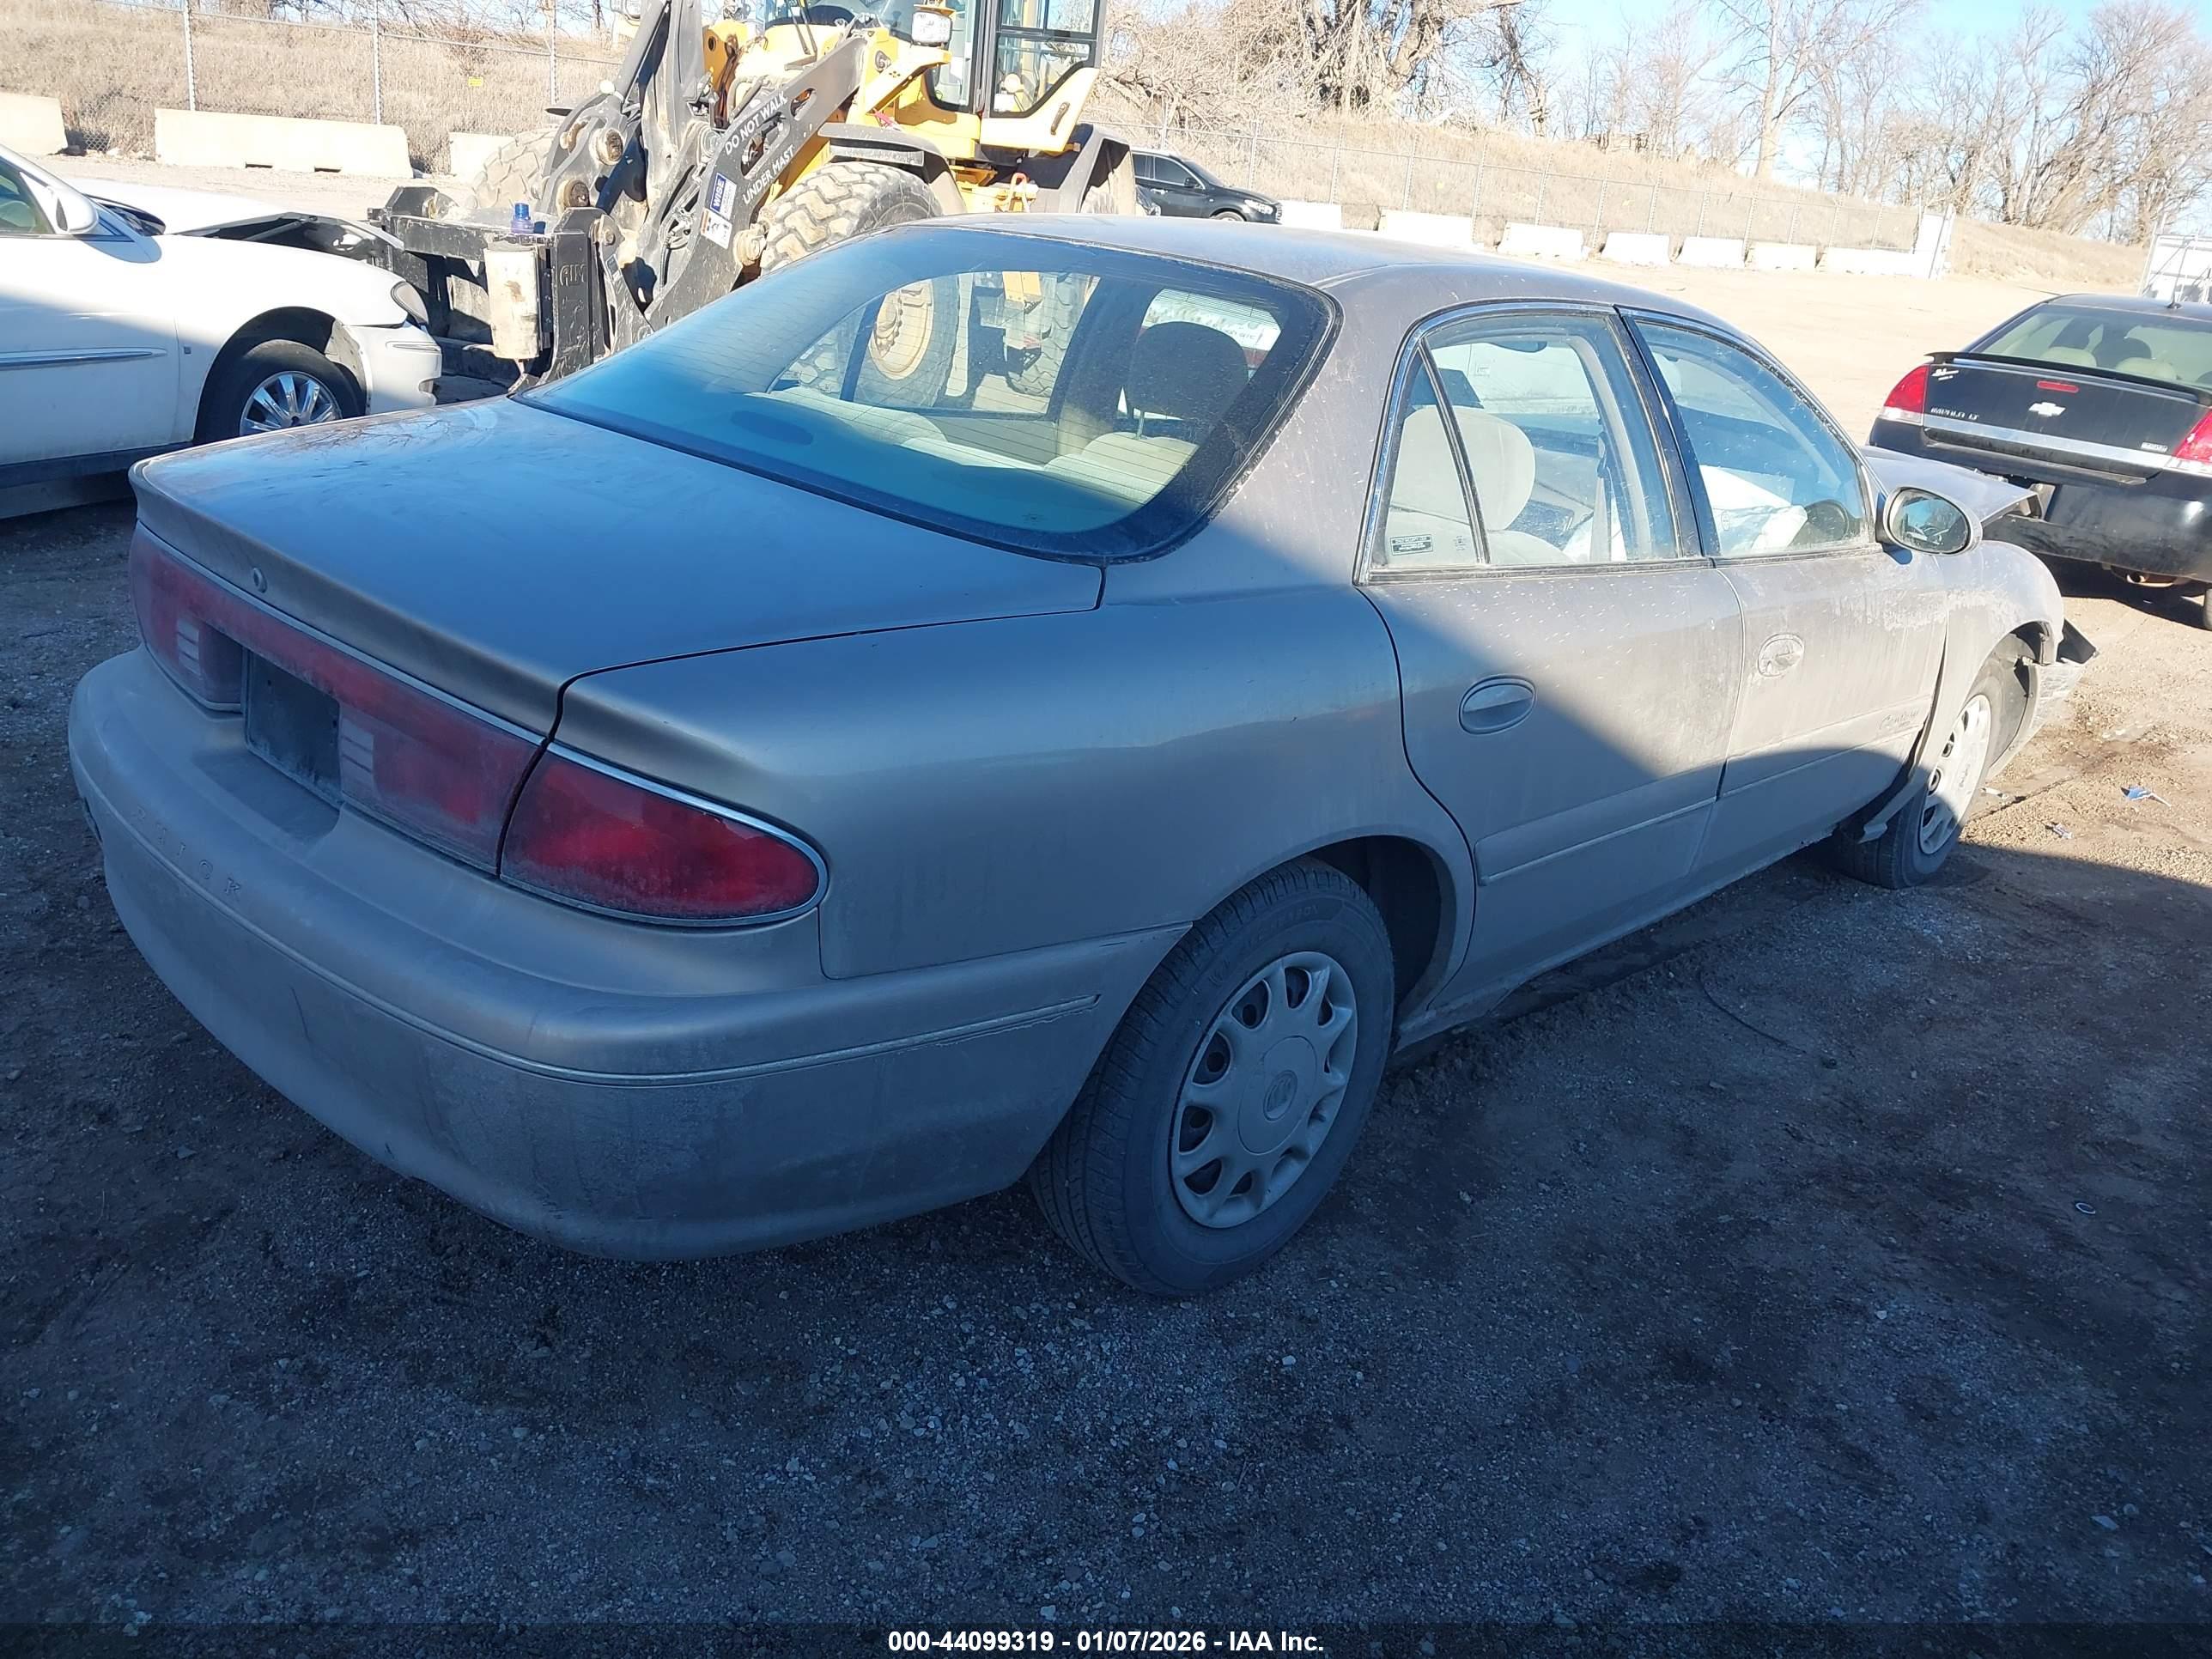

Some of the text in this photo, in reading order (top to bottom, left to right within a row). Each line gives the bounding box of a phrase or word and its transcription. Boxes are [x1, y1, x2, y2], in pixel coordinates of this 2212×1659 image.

[725, 91, 788, 155] DO NOT WALK
[712, 178, 726, 208] WISE
[743, 144, 795, 204] UNDER MAST
